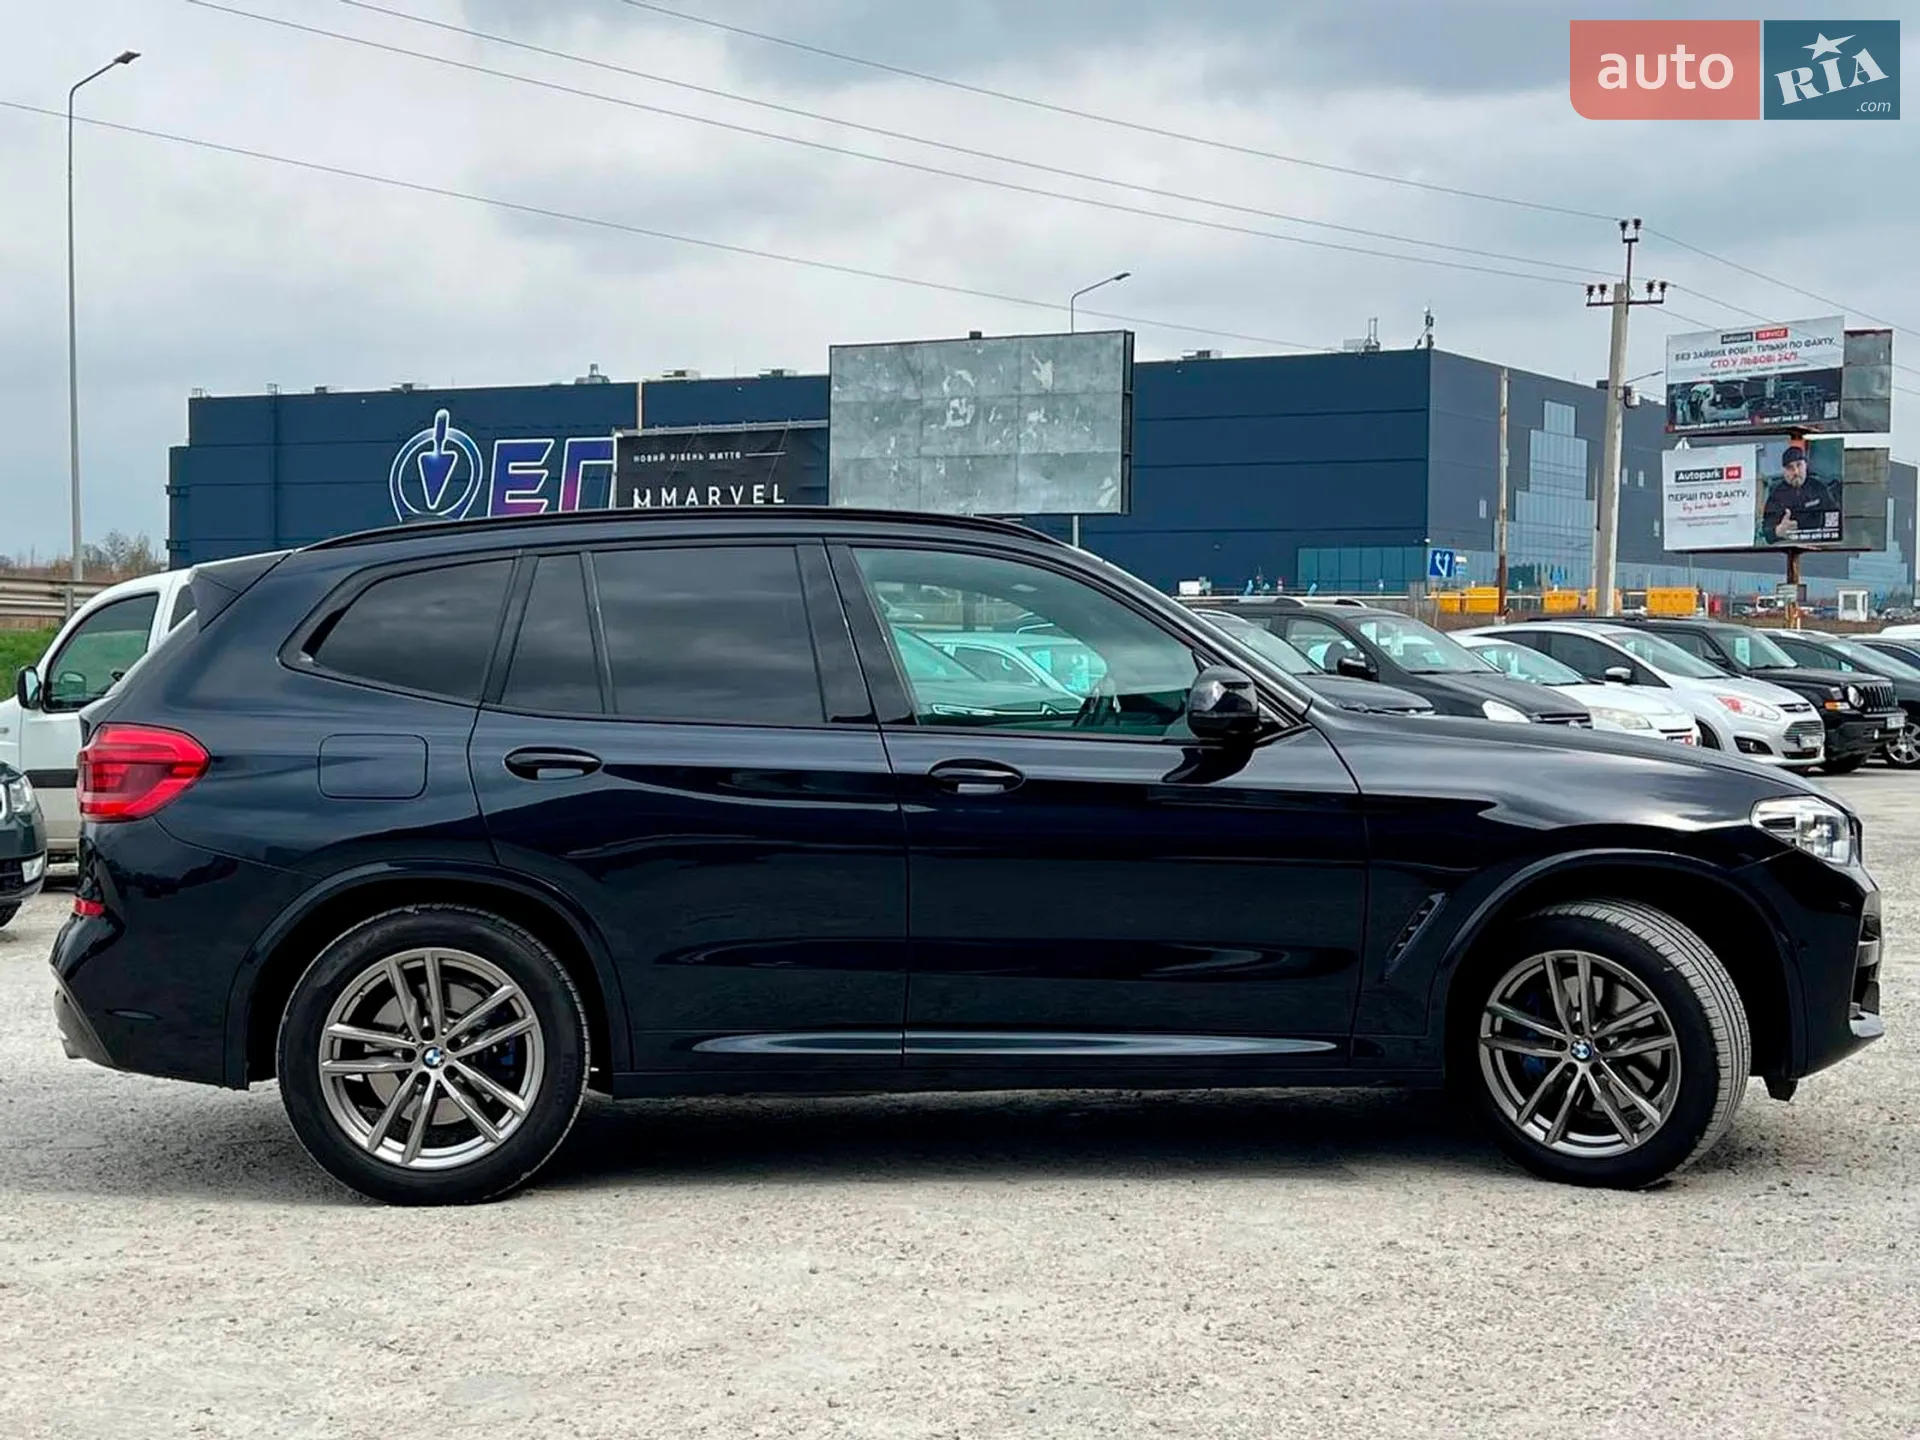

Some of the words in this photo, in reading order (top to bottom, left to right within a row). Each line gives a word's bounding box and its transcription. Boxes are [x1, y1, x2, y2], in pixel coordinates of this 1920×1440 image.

[1709, 359, 1730, 369] СТО
[633, 452, 666, 463] НОВИЙ
[669, 451, 706, 462] РІВЕНЬ
[1677, 468, 1721, 482] Autopark
[1699, 491, 1714, 501] ПО
